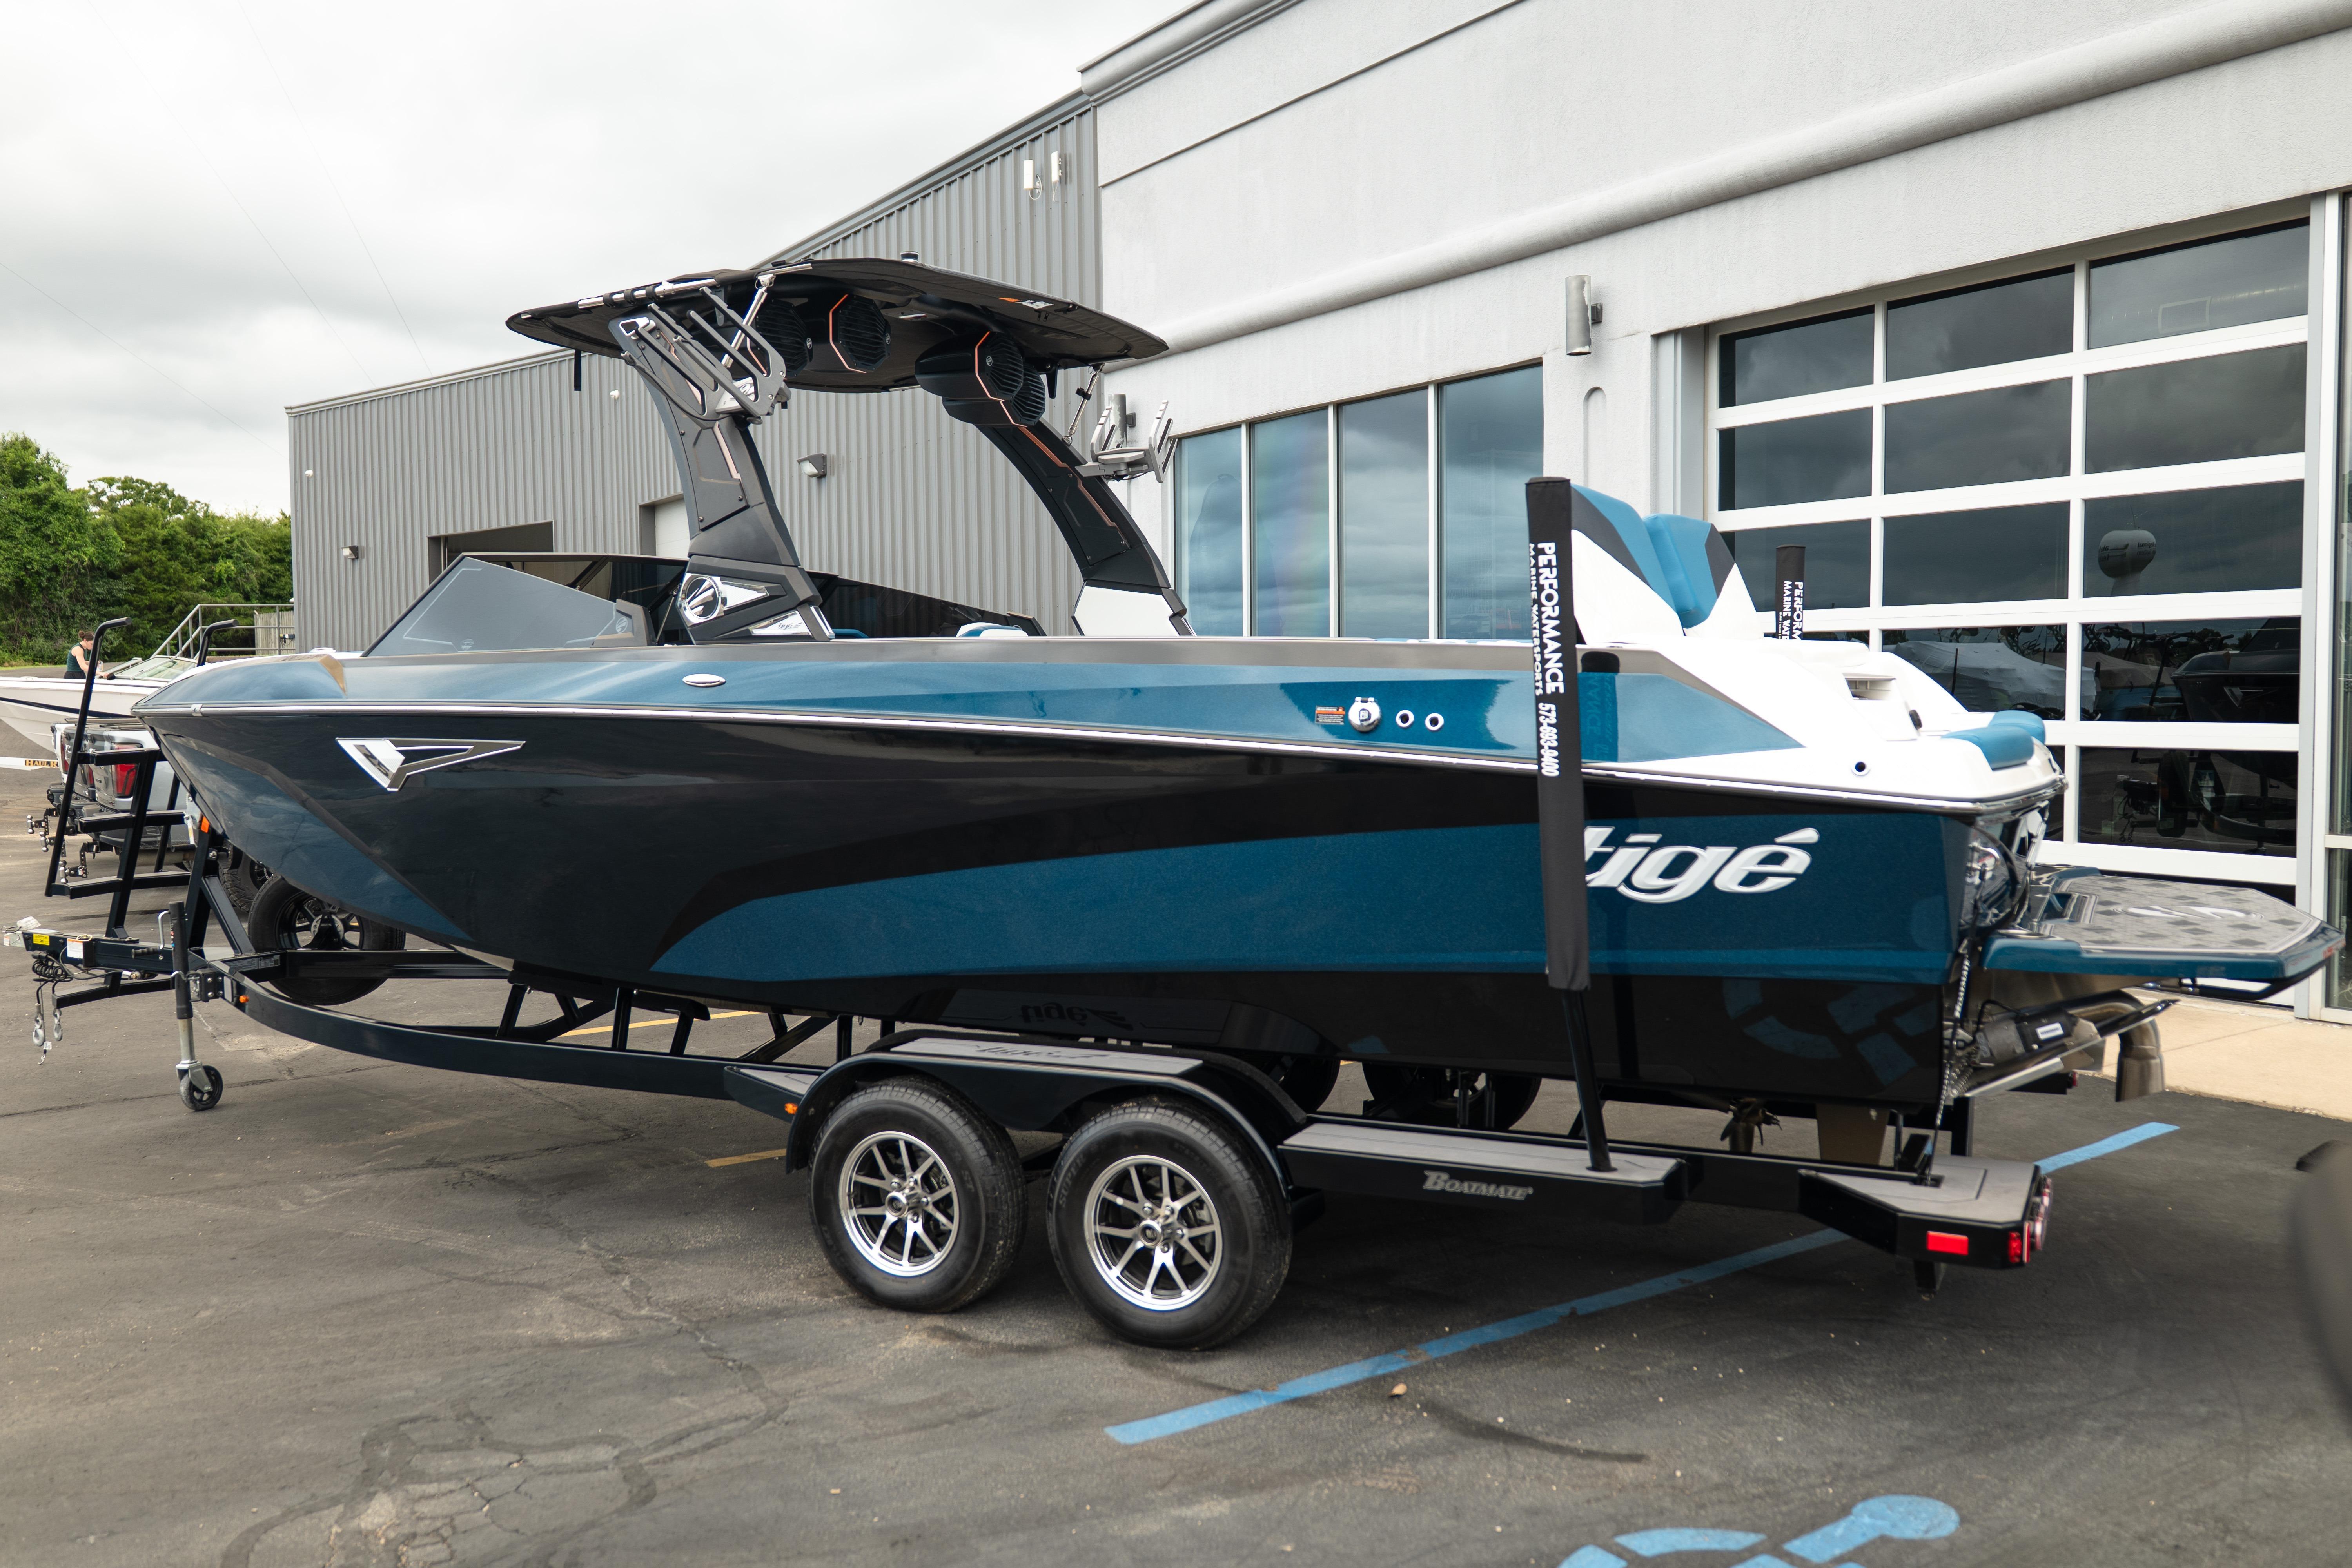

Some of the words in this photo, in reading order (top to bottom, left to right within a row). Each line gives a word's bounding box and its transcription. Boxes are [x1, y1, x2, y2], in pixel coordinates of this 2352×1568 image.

[1529, 543, 1537, 599] MARINE
[1782, 581, 1792, 617] MARINE
[1532, 604, 1543, 697] WATERSPORTS
[1538, 542, 1564, 694] PERFORMANCE
[1538, 702, 1560, 777] 573-693-9400
